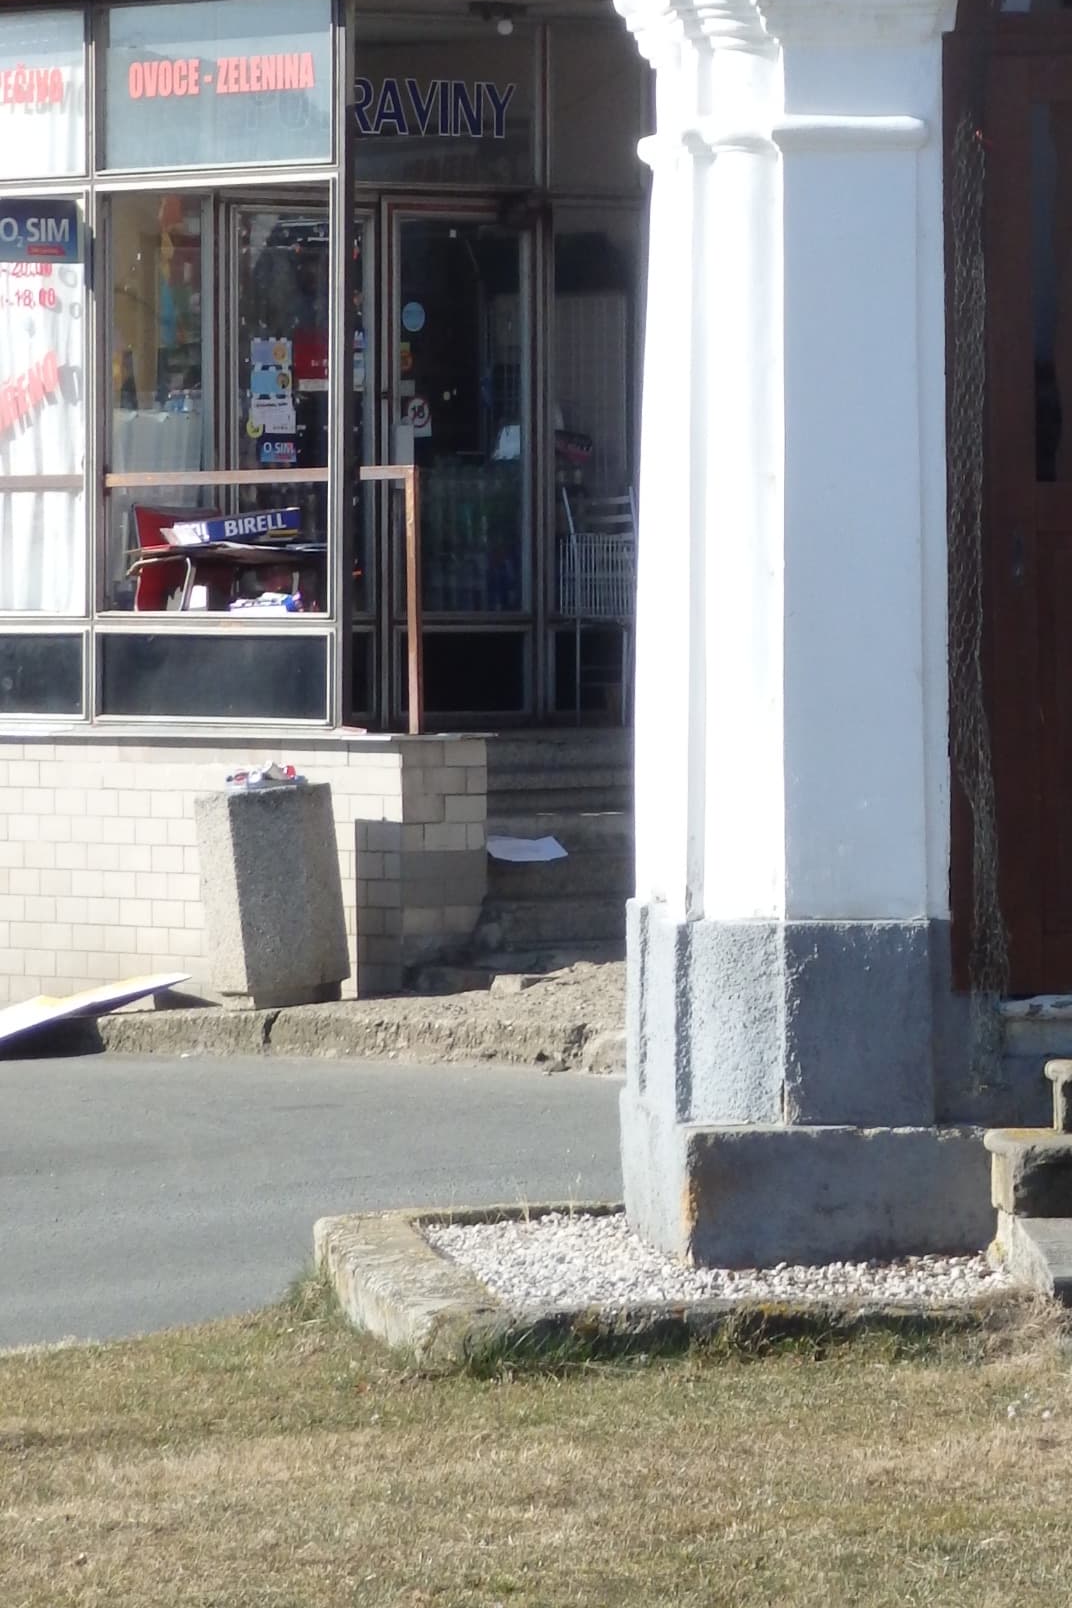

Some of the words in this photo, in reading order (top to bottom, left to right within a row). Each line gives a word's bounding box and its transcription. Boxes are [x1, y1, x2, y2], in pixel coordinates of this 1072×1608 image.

[0, 61, 64, 105] EČIVO
[129, 59, 200, 100] OVOCE
[216, 52, 314, 92] ZELENINA
[26, 217, 69, 243] SIM
[225, 513, 286, 537] BIRELL
